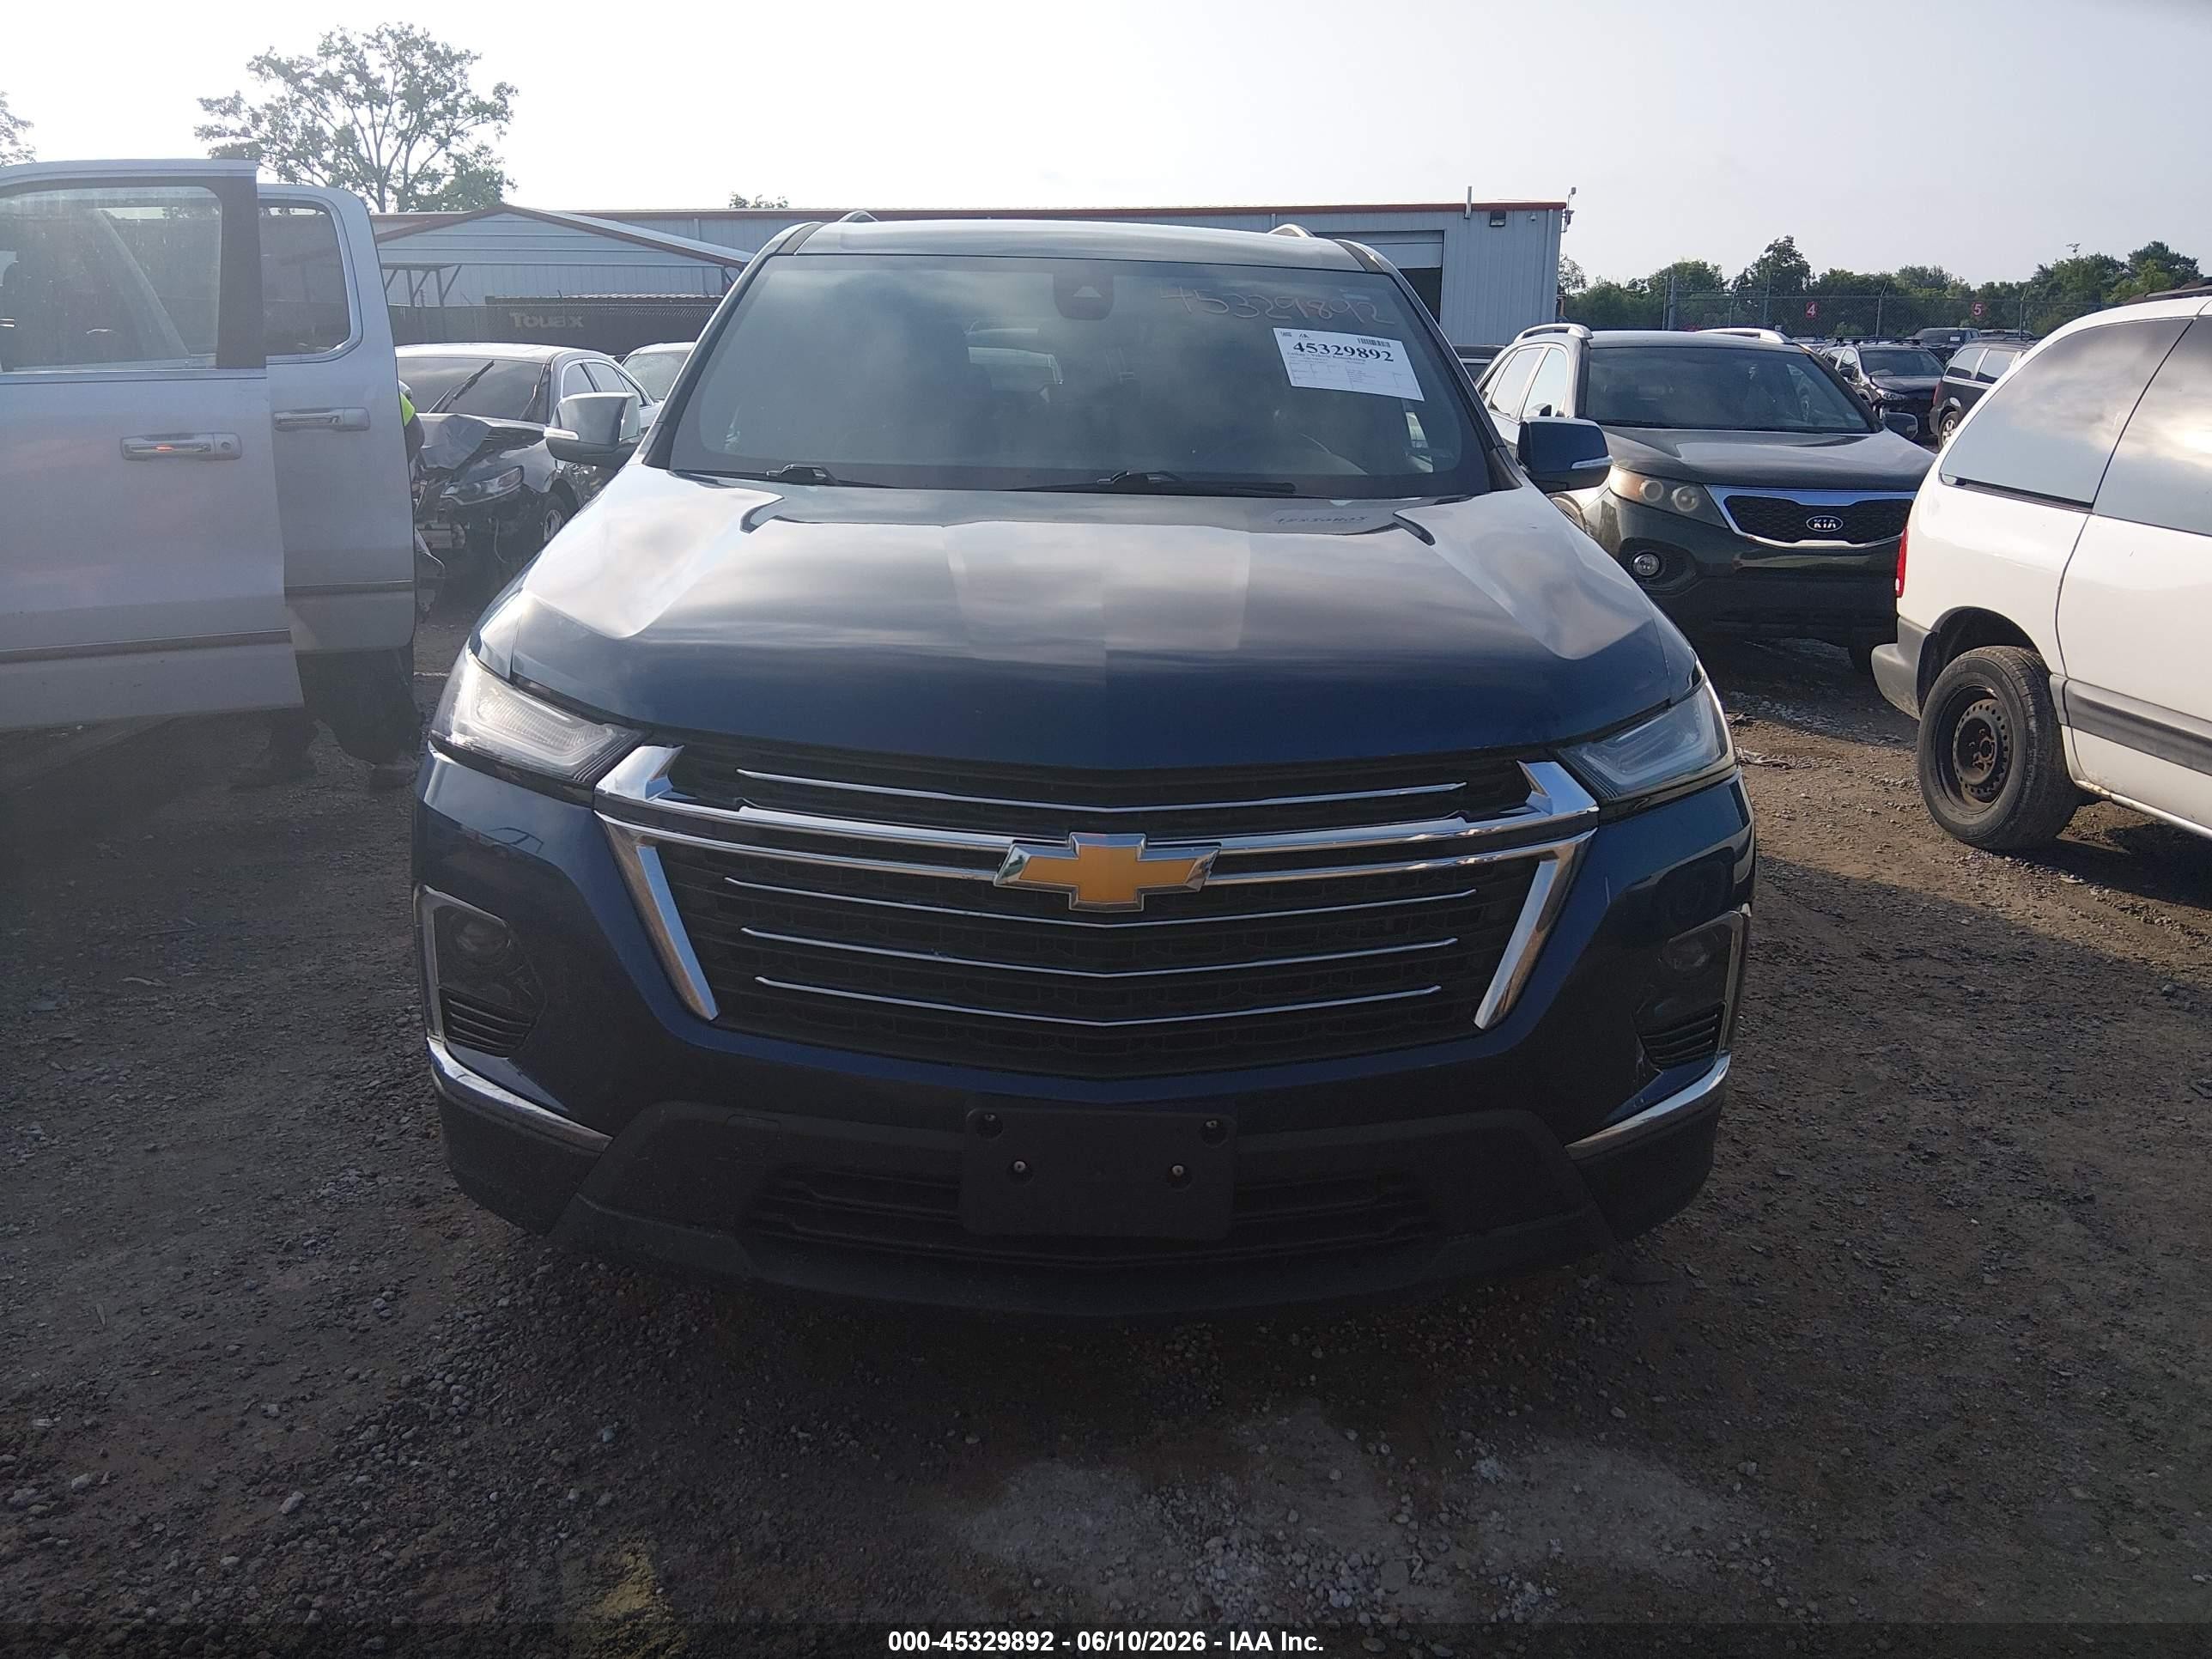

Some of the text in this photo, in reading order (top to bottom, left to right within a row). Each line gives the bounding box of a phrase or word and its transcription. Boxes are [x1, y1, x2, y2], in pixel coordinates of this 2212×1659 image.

[1806, 302, 1816, 317] 4
[1973, 303, 1983, 316] 5
[1292, 342, 1395, 362] 45329892
[1813, 519, 1837, 529] KIA
